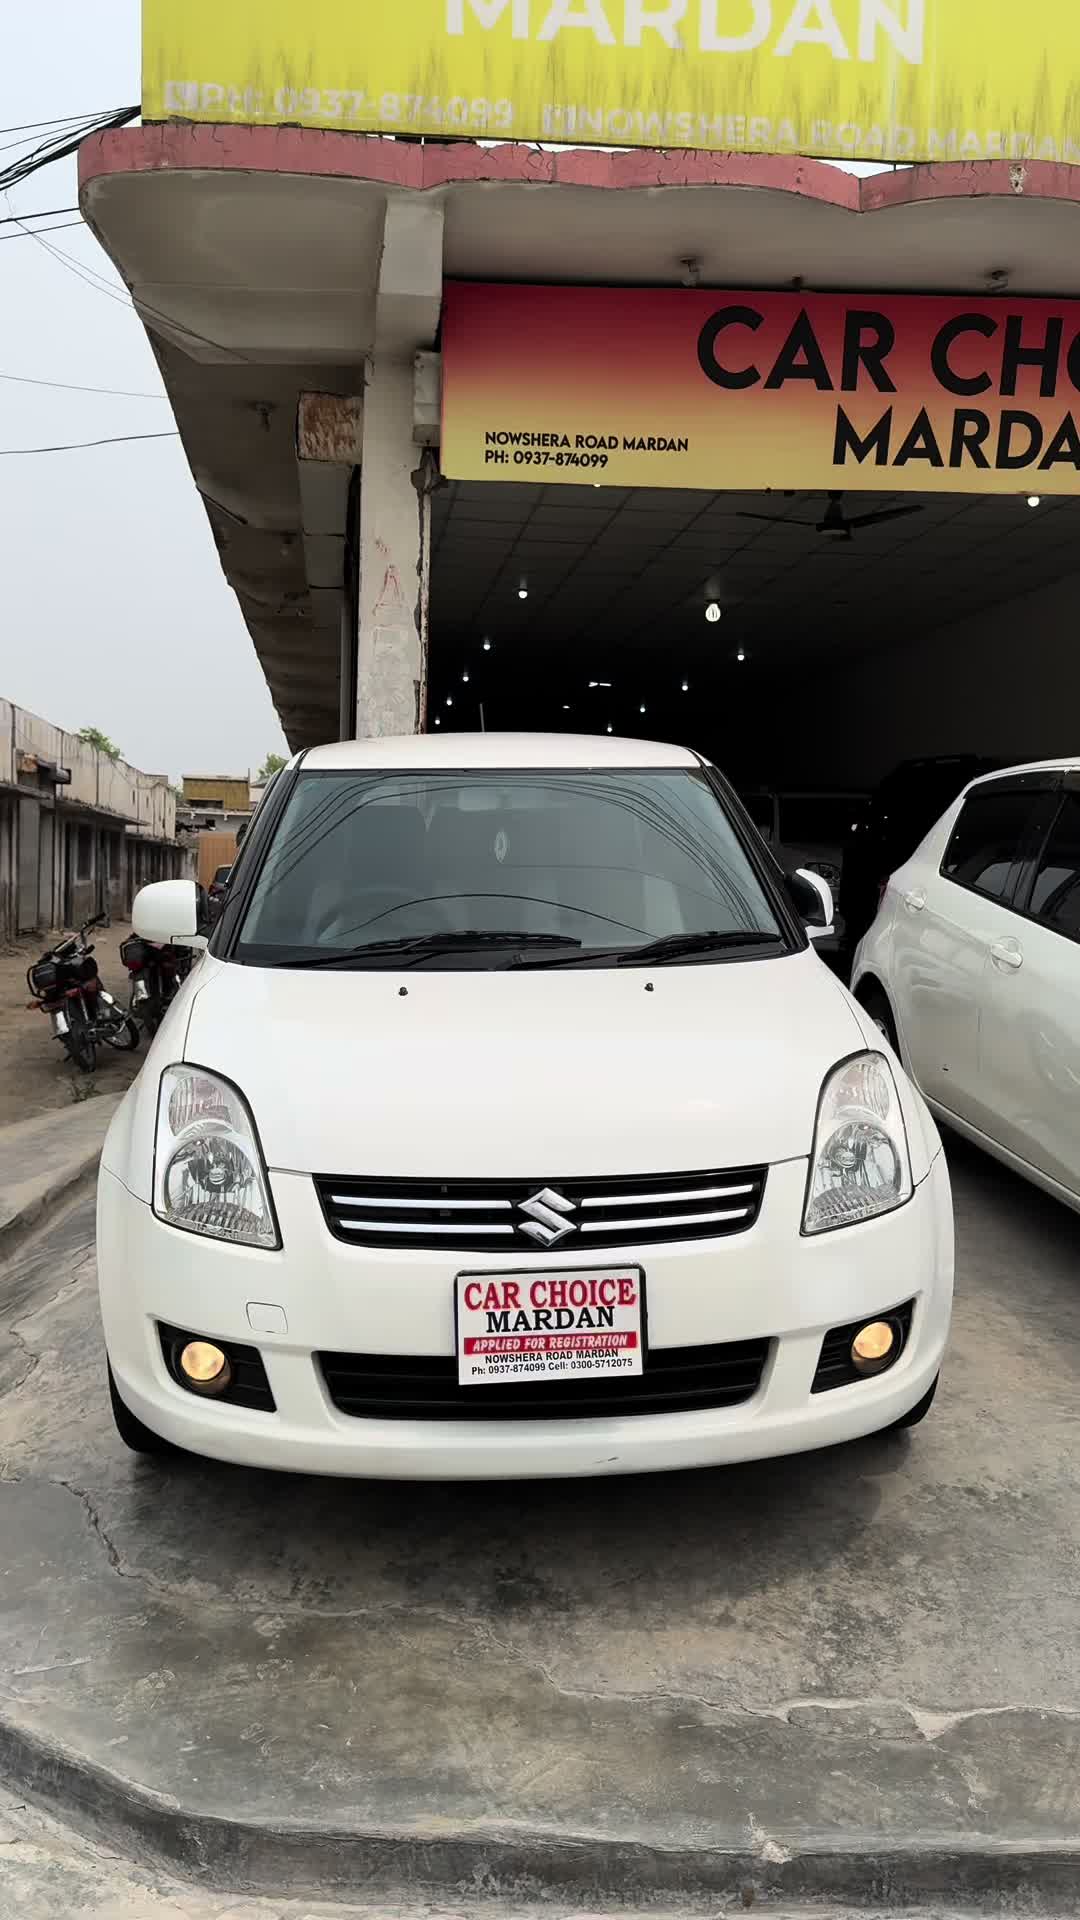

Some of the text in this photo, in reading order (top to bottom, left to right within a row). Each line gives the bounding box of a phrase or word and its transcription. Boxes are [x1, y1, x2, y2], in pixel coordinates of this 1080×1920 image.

[445, 0, 923, 65] MARDAN
[274, 87, 514, 128] 0937-874099
[577, 106, 799, 145] NOWSHERA
[811, 119, 917, 152] ROAD
[697, 305, 1080, 398] CAR CH
[485, 431, 688, 451] NOWSHERA ROAD MARDAN
[485, 450, 608, 468] PH: 0937-874099
[464, 1279, 636, 1311] CAR CHOICE
[486, 1306, 615, 1333] MARDAN
[473, 1334, 628, 1352] APPLIED FOR REGISTRATION
[485, 1348, 618, 1364] NOWSHERA ROAD MARDAN
[471, 1358, 633, 1375] Ph: 0937-874099 Cell: 0300-5712075
